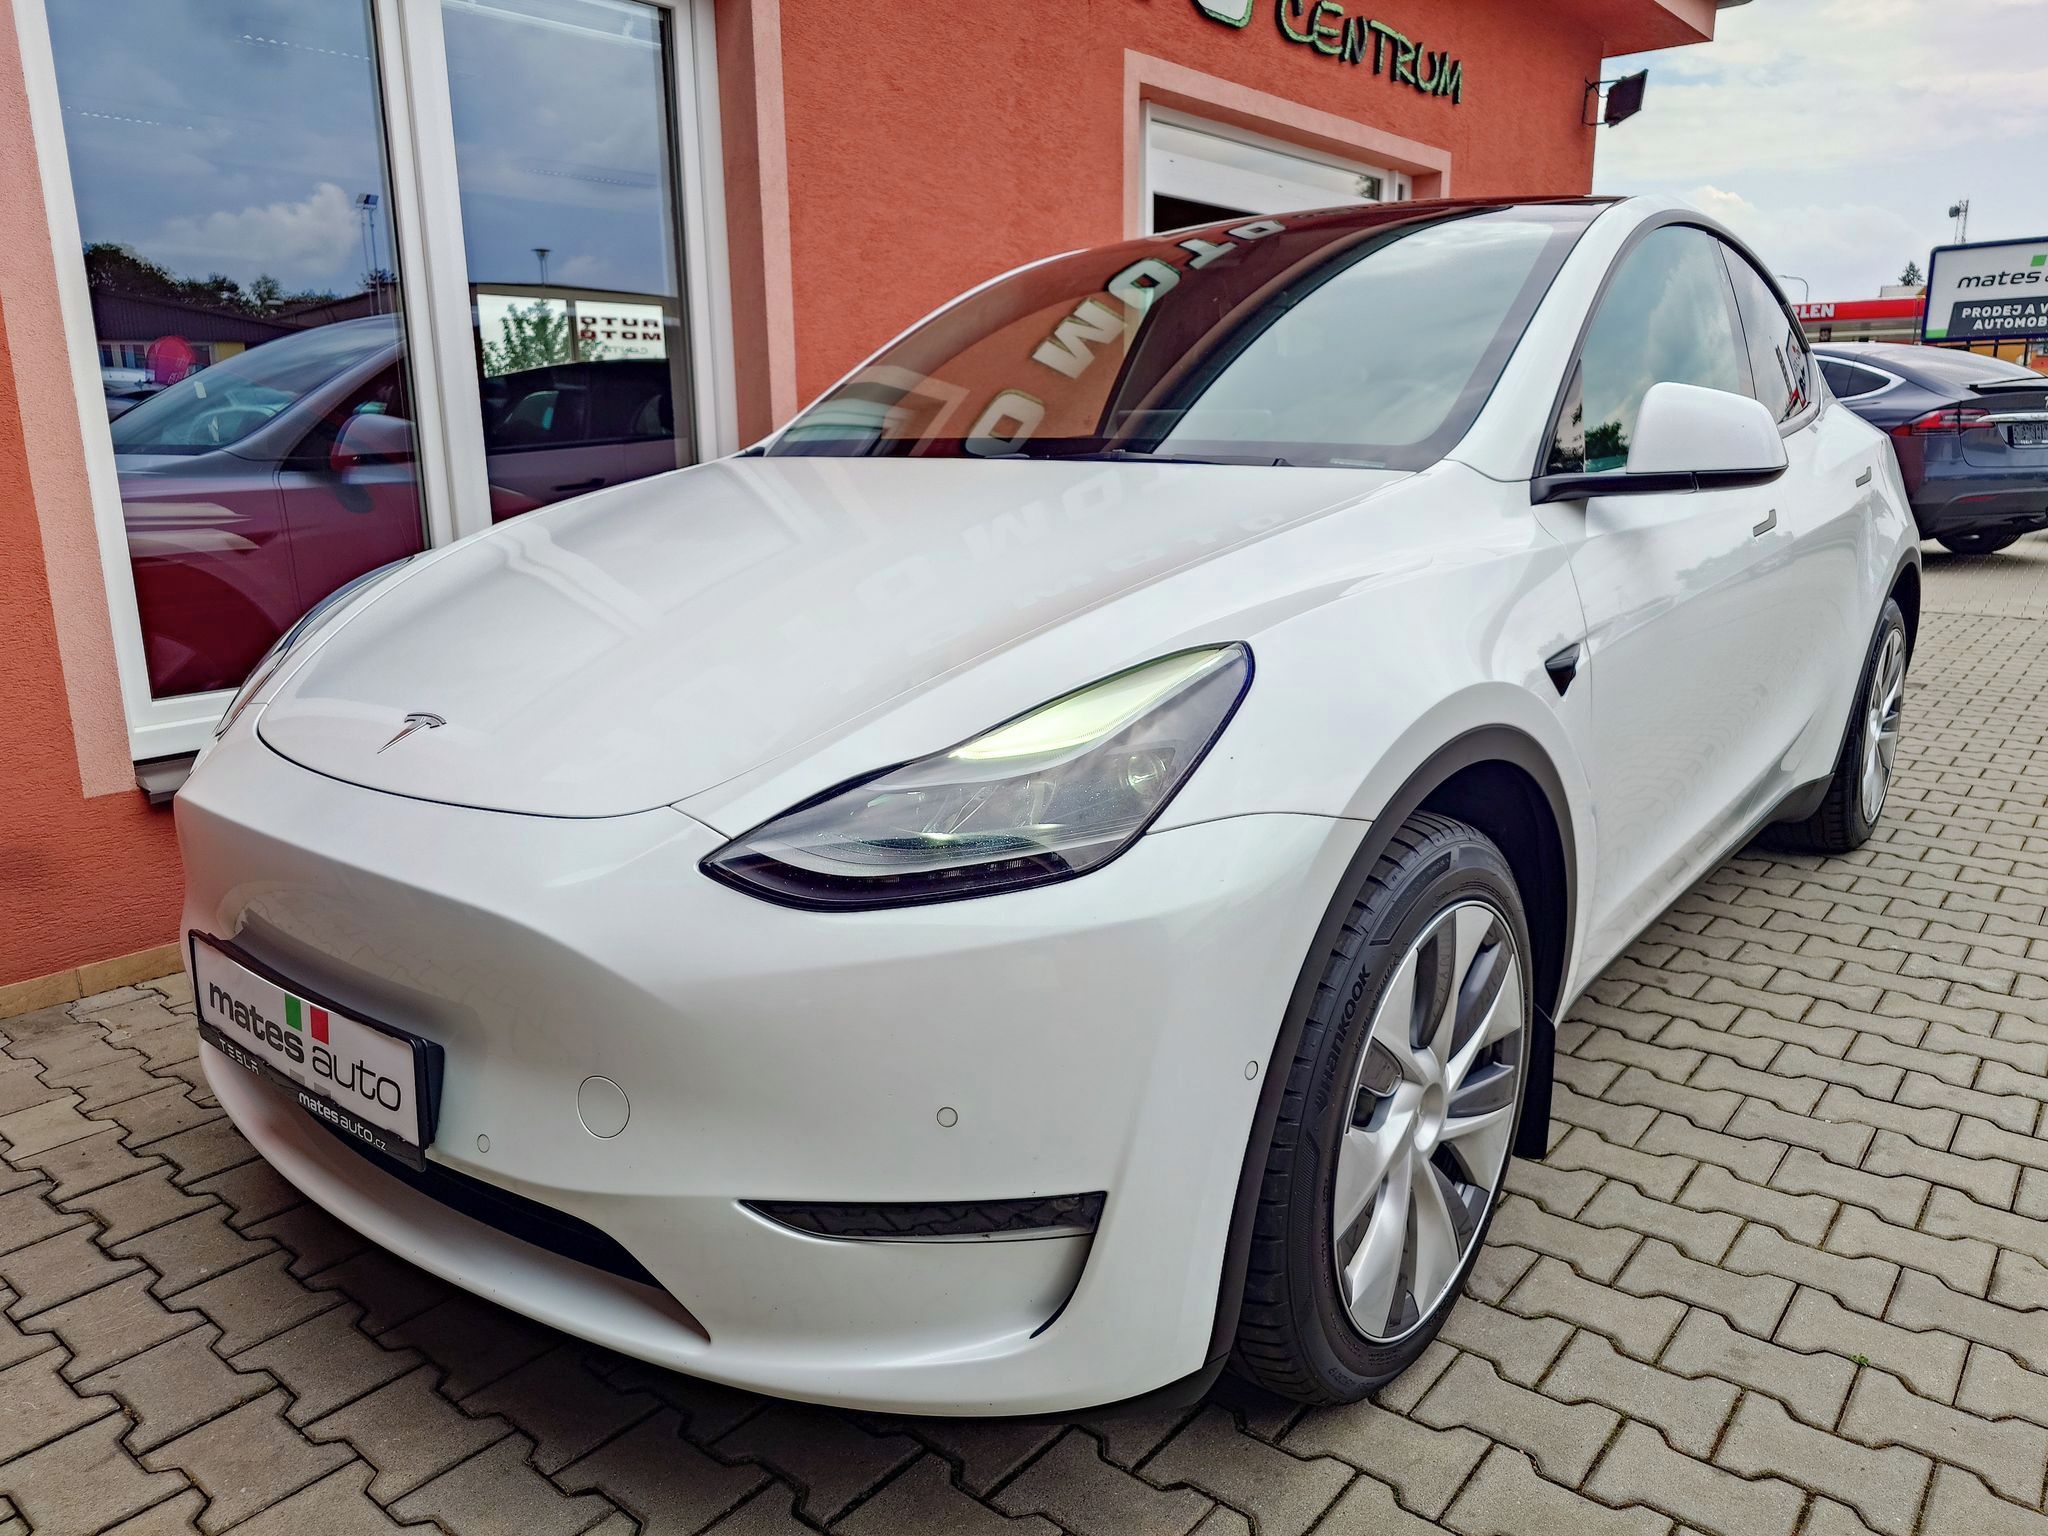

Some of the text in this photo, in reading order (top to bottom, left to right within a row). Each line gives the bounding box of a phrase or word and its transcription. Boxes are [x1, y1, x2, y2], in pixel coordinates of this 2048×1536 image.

[1275, 0, 1462, 104] CENTRUM
[1957, 270, 2041, 289] mates
[1791, 303, 1835, 319] RLEN
[1961, 304, 2022, 319] PRODEJ
[2025, 303, 2036, 315] A
[209, 982, 402, 1112] mates auto
[219, 1038, 260, 1076] TESLA
